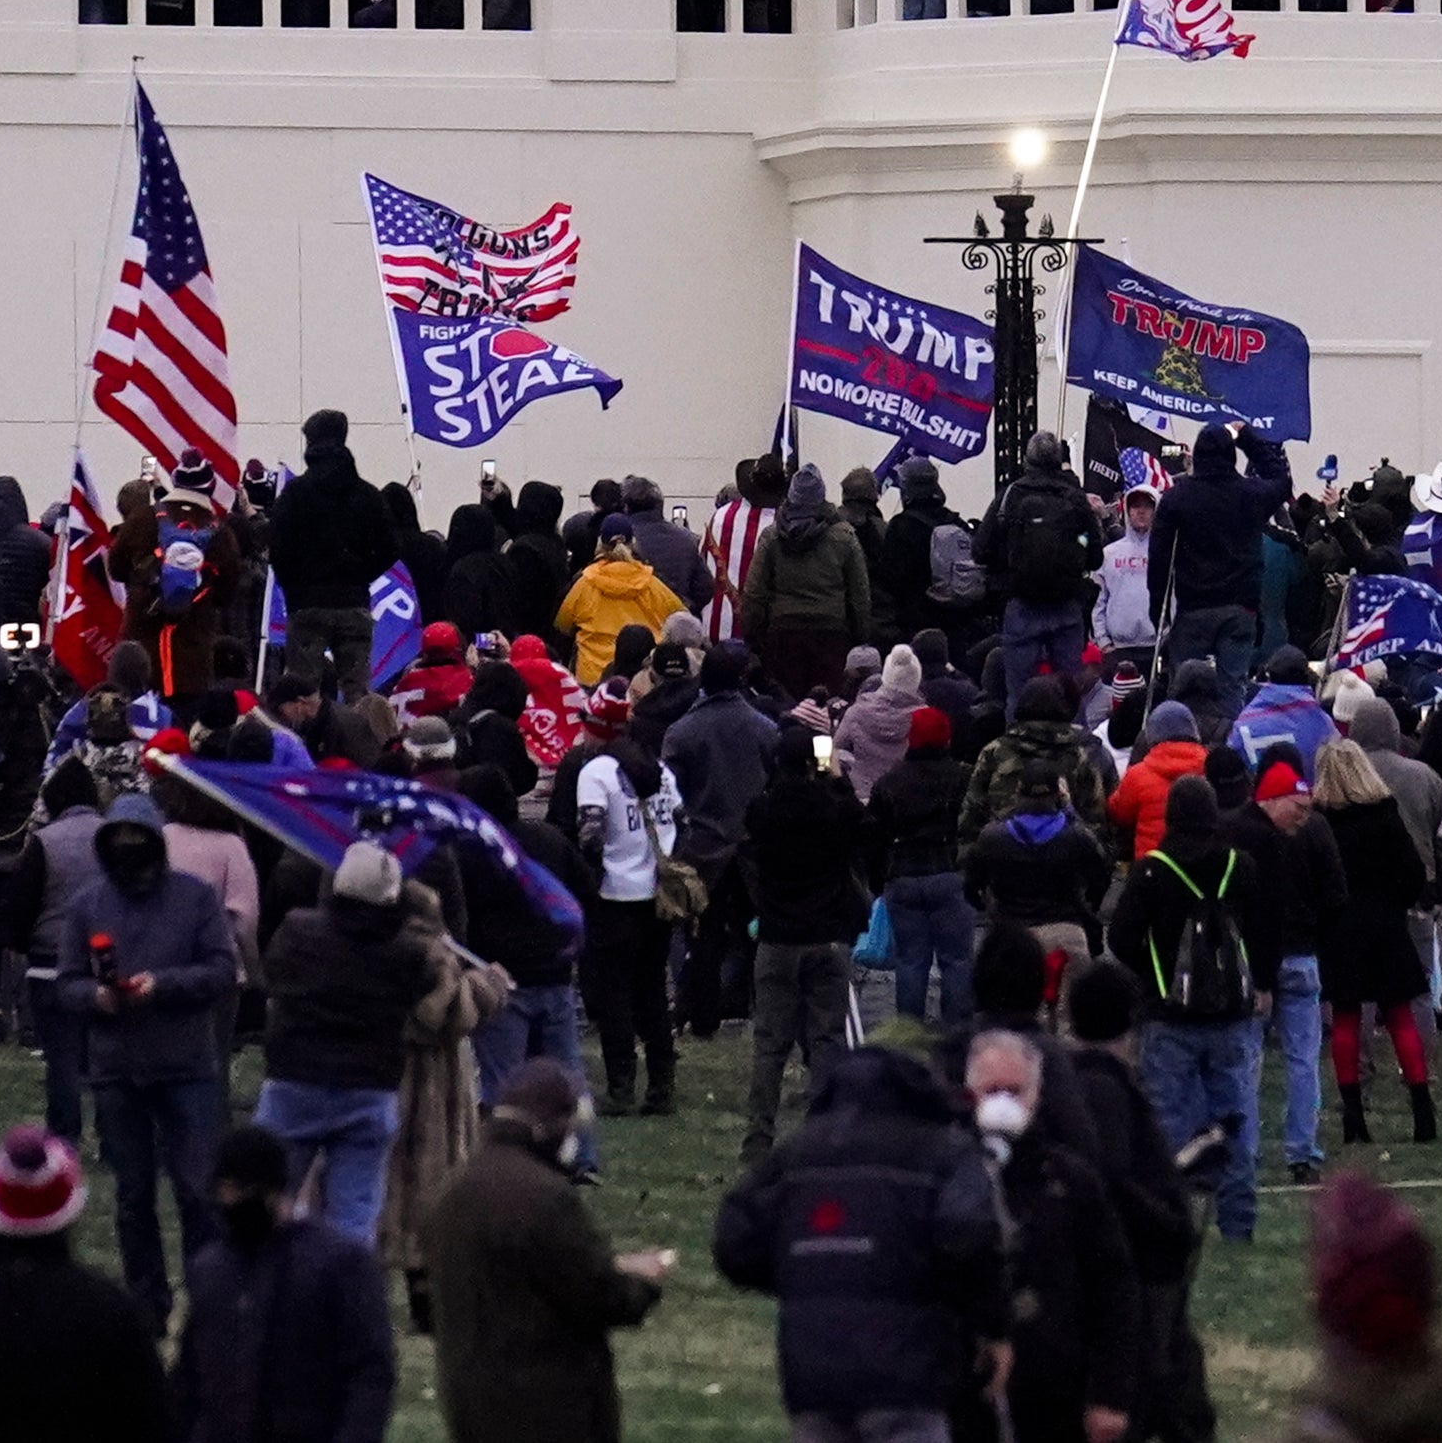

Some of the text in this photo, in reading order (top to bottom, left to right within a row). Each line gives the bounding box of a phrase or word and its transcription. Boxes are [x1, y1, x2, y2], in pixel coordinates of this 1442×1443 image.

[420, 323, 471, 340] FIGHT
[810, 269, 995, 381] TRUMP
[1107, 290, 1266, 364] TRUMP
[799, 369, 834, 395] NO
[834, 379, 902, 417] MORE
[1093, 369, 1138, 391] KEEP
[1141, 385, 1216, 414] AMERICA
[1349, 637, 1405, 668] KEEP
